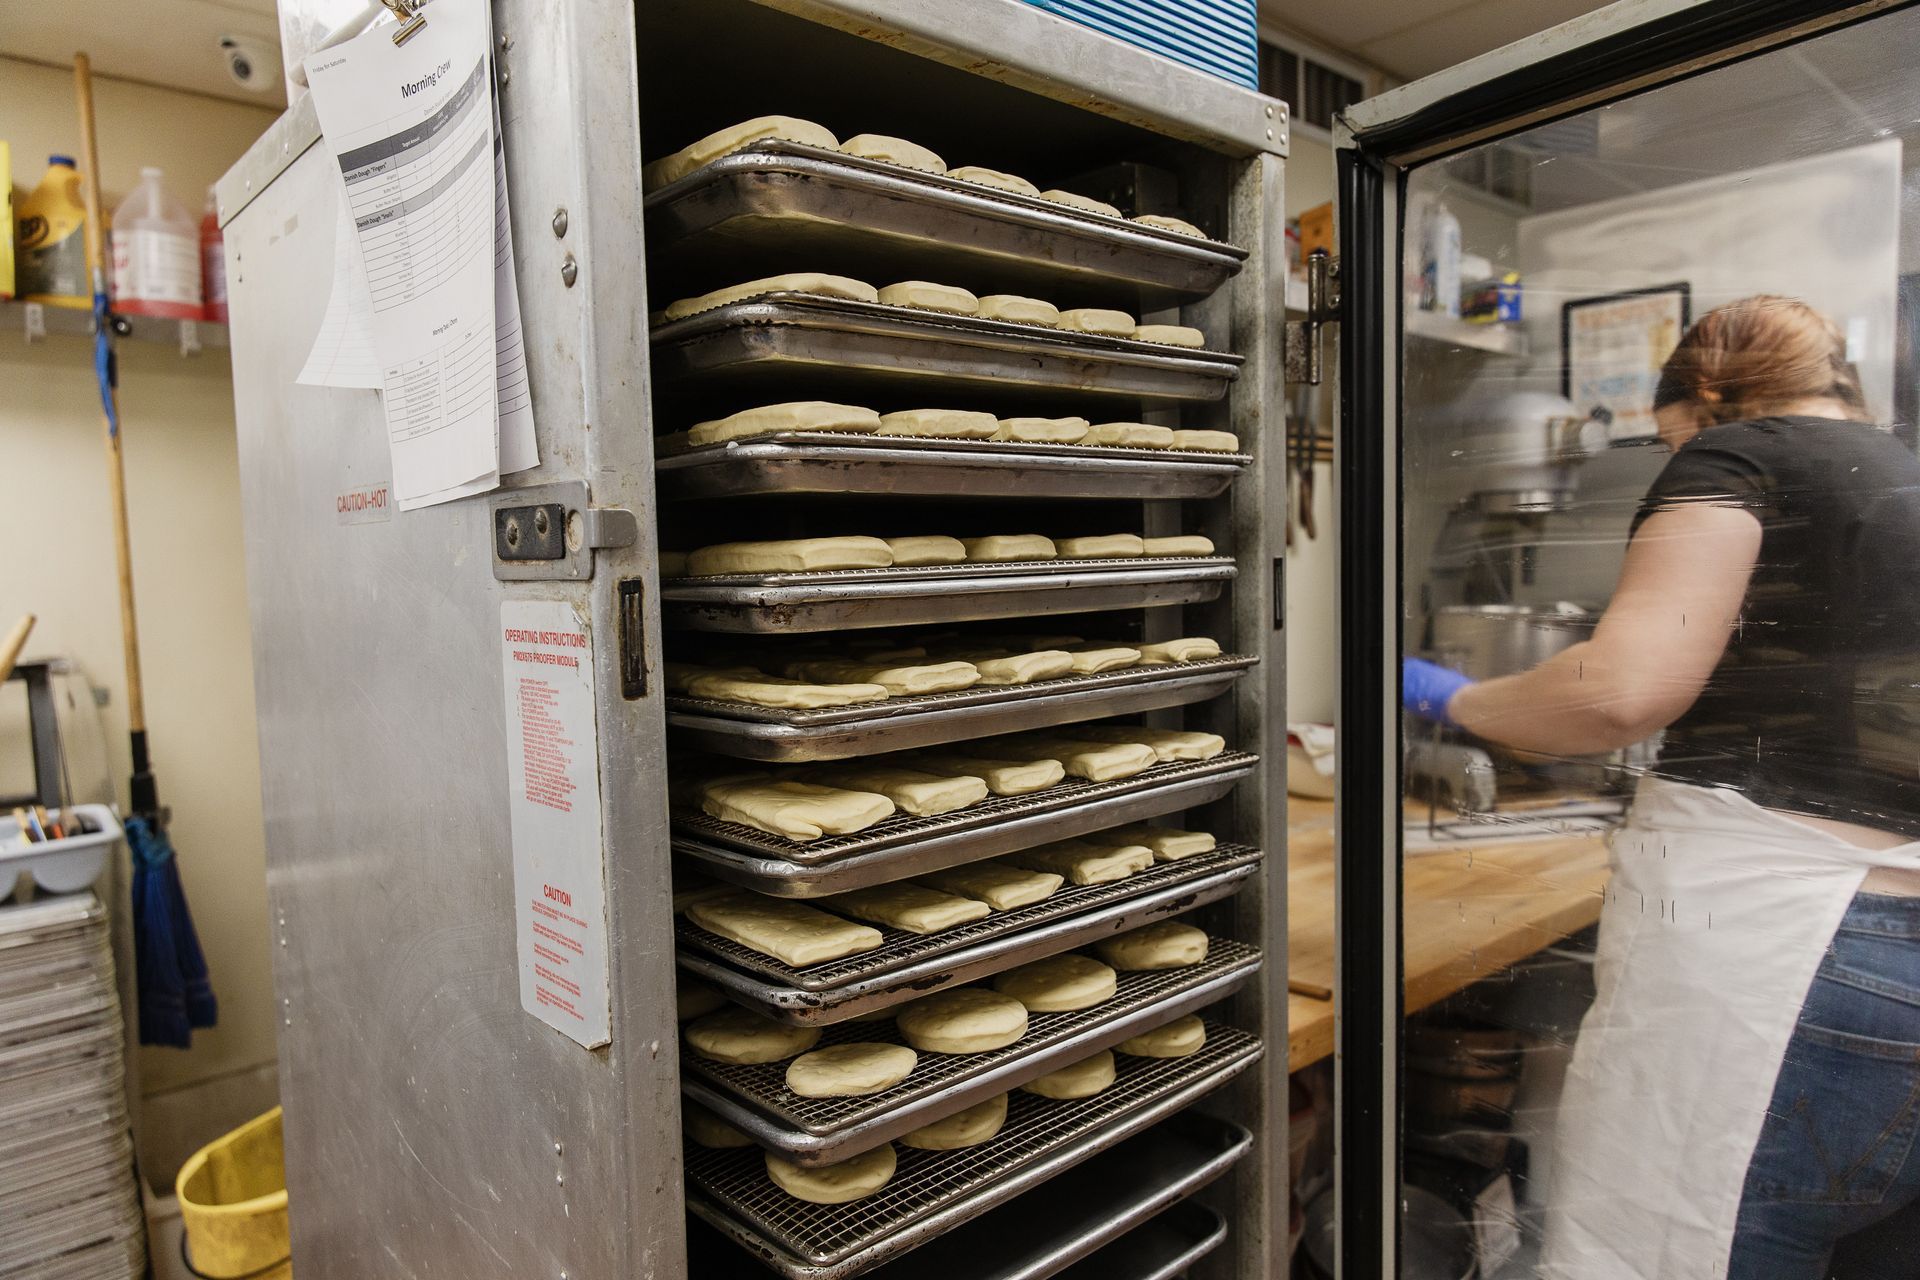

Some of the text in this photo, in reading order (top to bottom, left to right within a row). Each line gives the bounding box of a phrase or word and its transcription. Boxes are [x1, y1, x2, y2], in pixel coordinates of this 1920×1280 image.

[401, 73, 437, 98] Morning
[437, 59, 451, 79] Crew
[344, 173, 358, 182] Danish
[358, 169, 371, 179] Dough
[357, 219, 370, 228] Danish
[370, 215, 381, 224] Dough
[337, 489, 387, 513] CAUTION-HOT
[505, 629, 586, 648] OPERATING INSTRUCTIONS
[533, 653, 556, 664] PROOFER
[556, 655, 579, 667] MODULE
[543, 884, 572, 907] CAUTION
